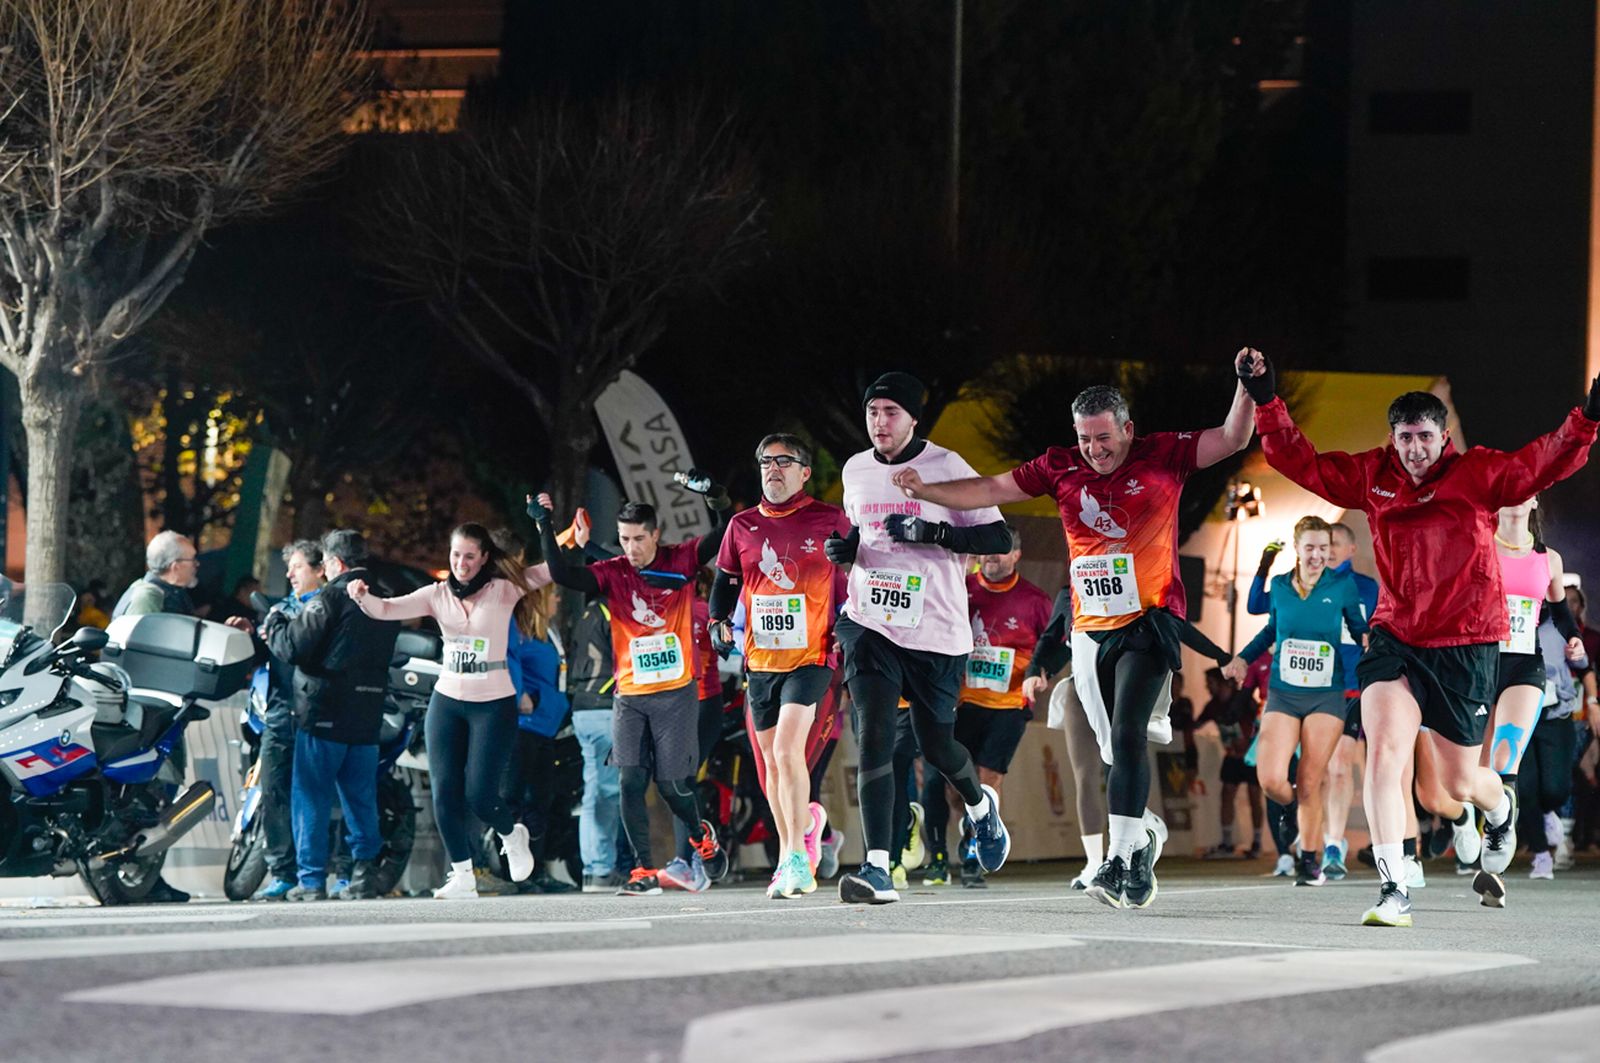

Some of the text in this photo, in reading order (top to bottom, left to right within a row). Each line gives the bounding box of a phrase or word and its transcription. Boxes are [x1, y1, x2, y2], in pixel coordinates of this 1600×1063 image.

[1094, 516, 1112, 532] 43
[770, 566, 783, 581] 43
[1083, 576, 1123, 597] 3168
[870, 587, 911, 609] 5795
[761, 614, 795, 631] 1899
[637, 650, 677, 668] 13546
[1290, 655, 1324, 672] 6905
[971, 660, 1006, 677] 13315
